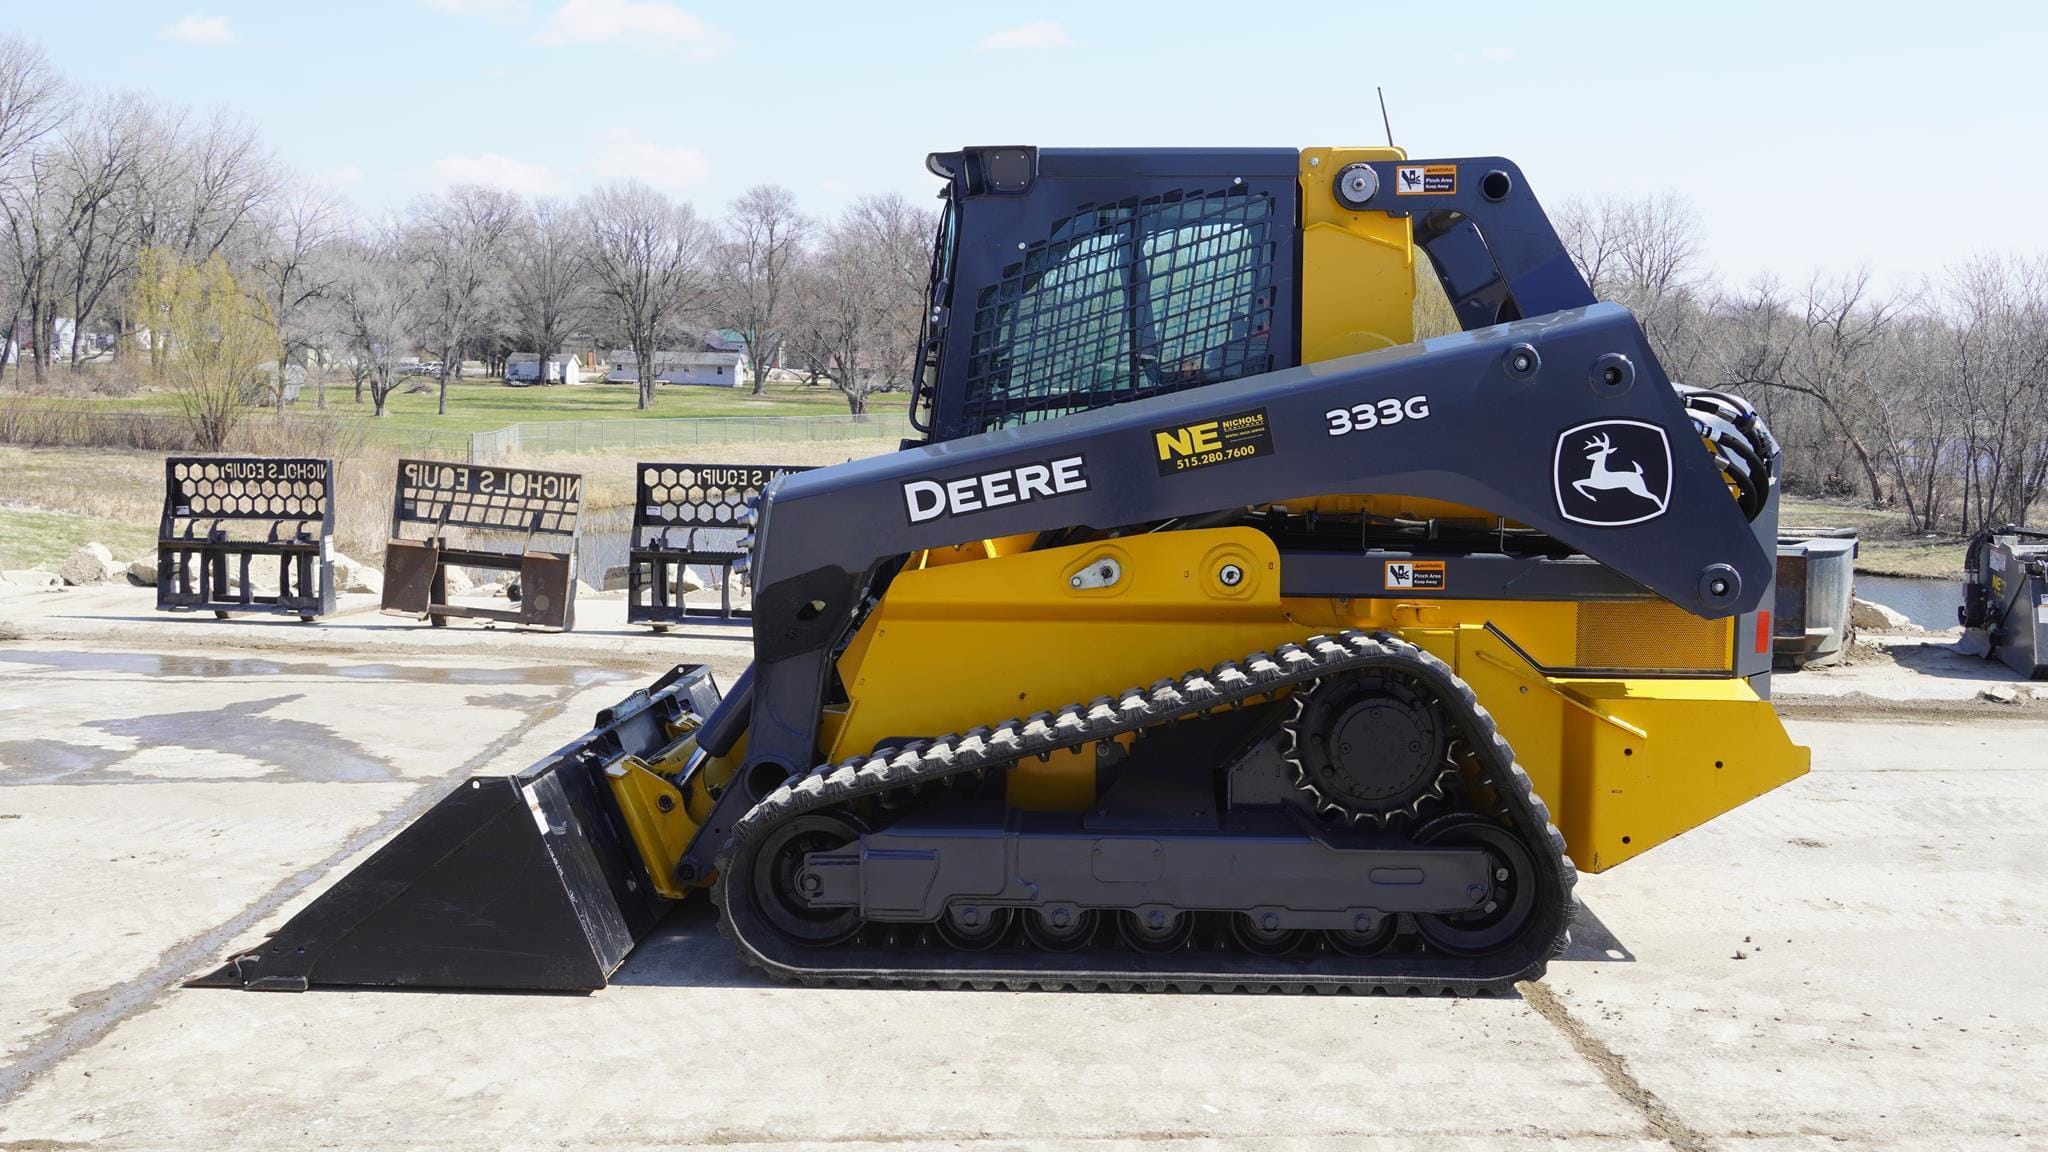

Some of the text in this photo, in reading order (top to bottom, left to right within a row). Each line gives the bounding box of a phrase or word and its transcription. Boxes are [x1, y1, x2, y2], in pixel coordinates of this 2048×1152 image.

[1222, 414, 1263, 428] NICHOLS
[1326, 396, 1429, 435] 333G
[1156, 421, 1222, 460] NE
[1177, 445, 1255, 469] 515.280.7600
[904, 456, 1087, 522] DEERE
